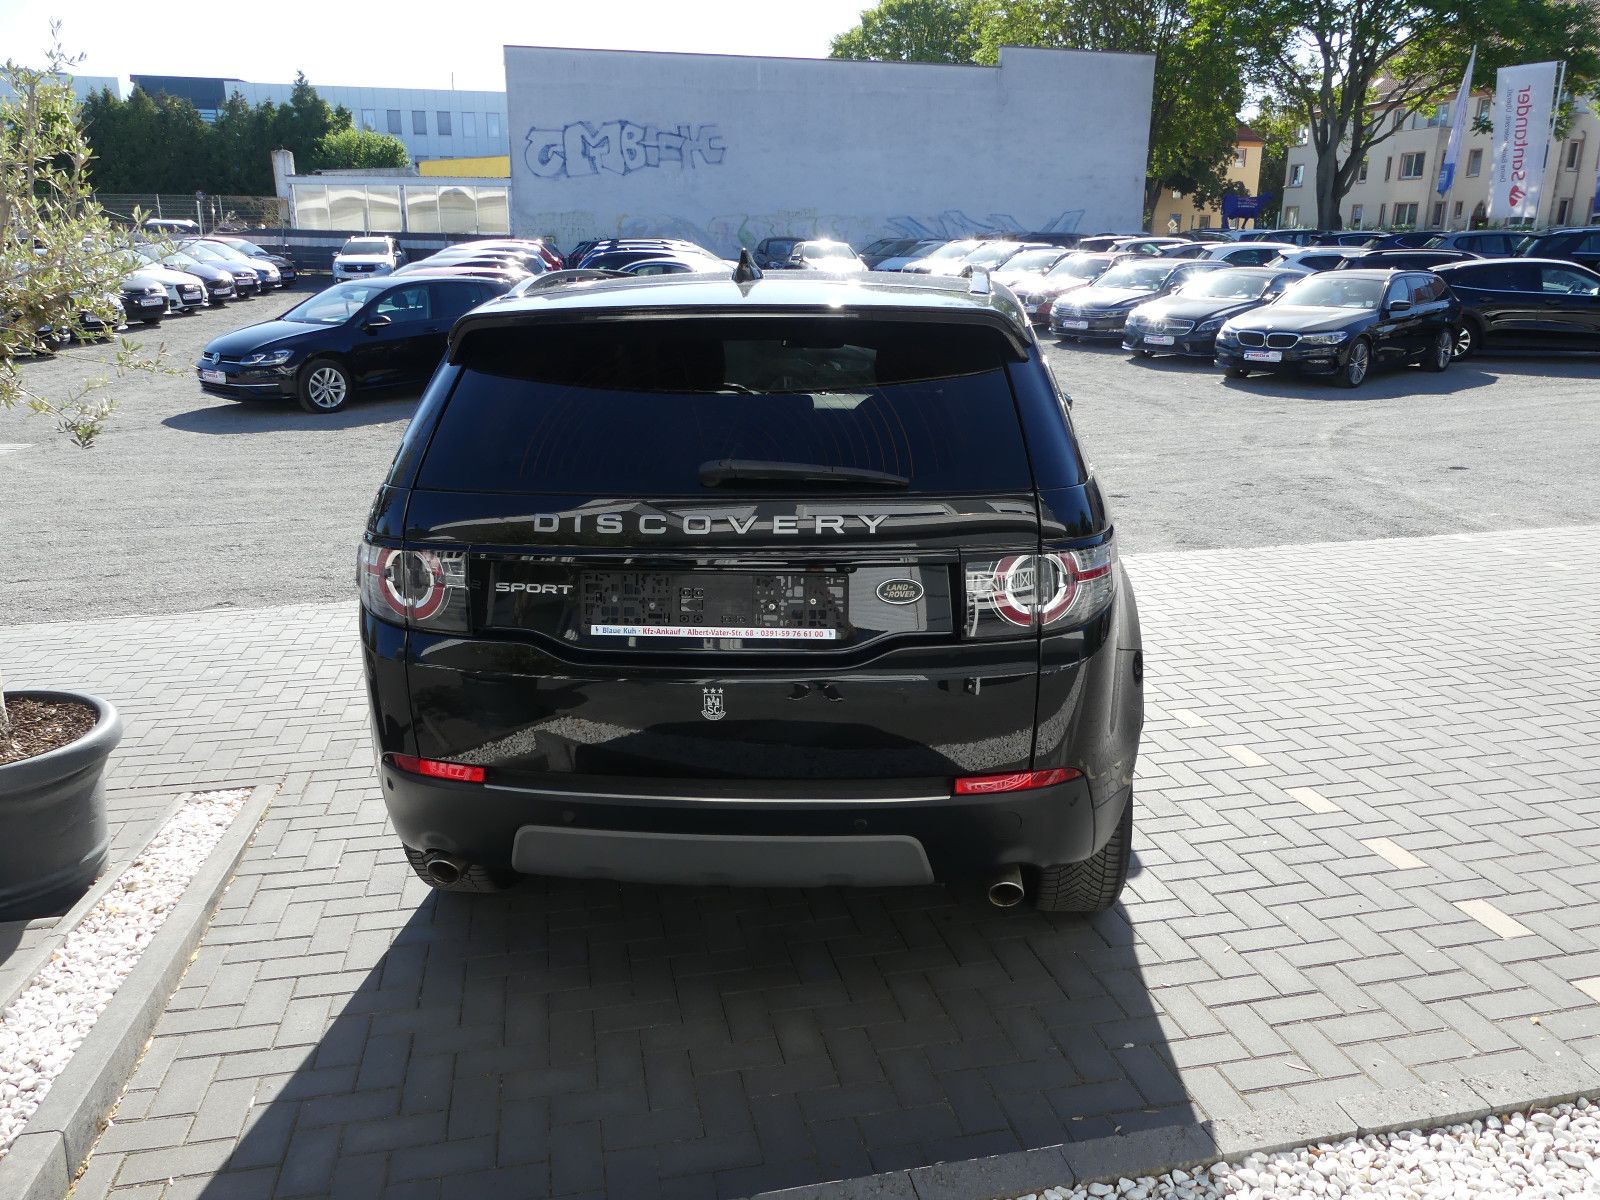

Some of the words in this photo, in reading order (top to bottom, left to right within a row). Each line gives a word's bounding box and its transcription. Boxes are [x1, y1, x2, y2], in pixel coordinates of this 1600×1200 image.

[533, 513, 890, 535] DISCOVERY
[495, 582, 574, 595] SPORT
[602, 626, 621, 634] Blaue
[687, 628, 743, 636] Albert-Vater-Str.
[760, 629, 790, 637] 0391-59
[707, 705, 720, 715] SC
